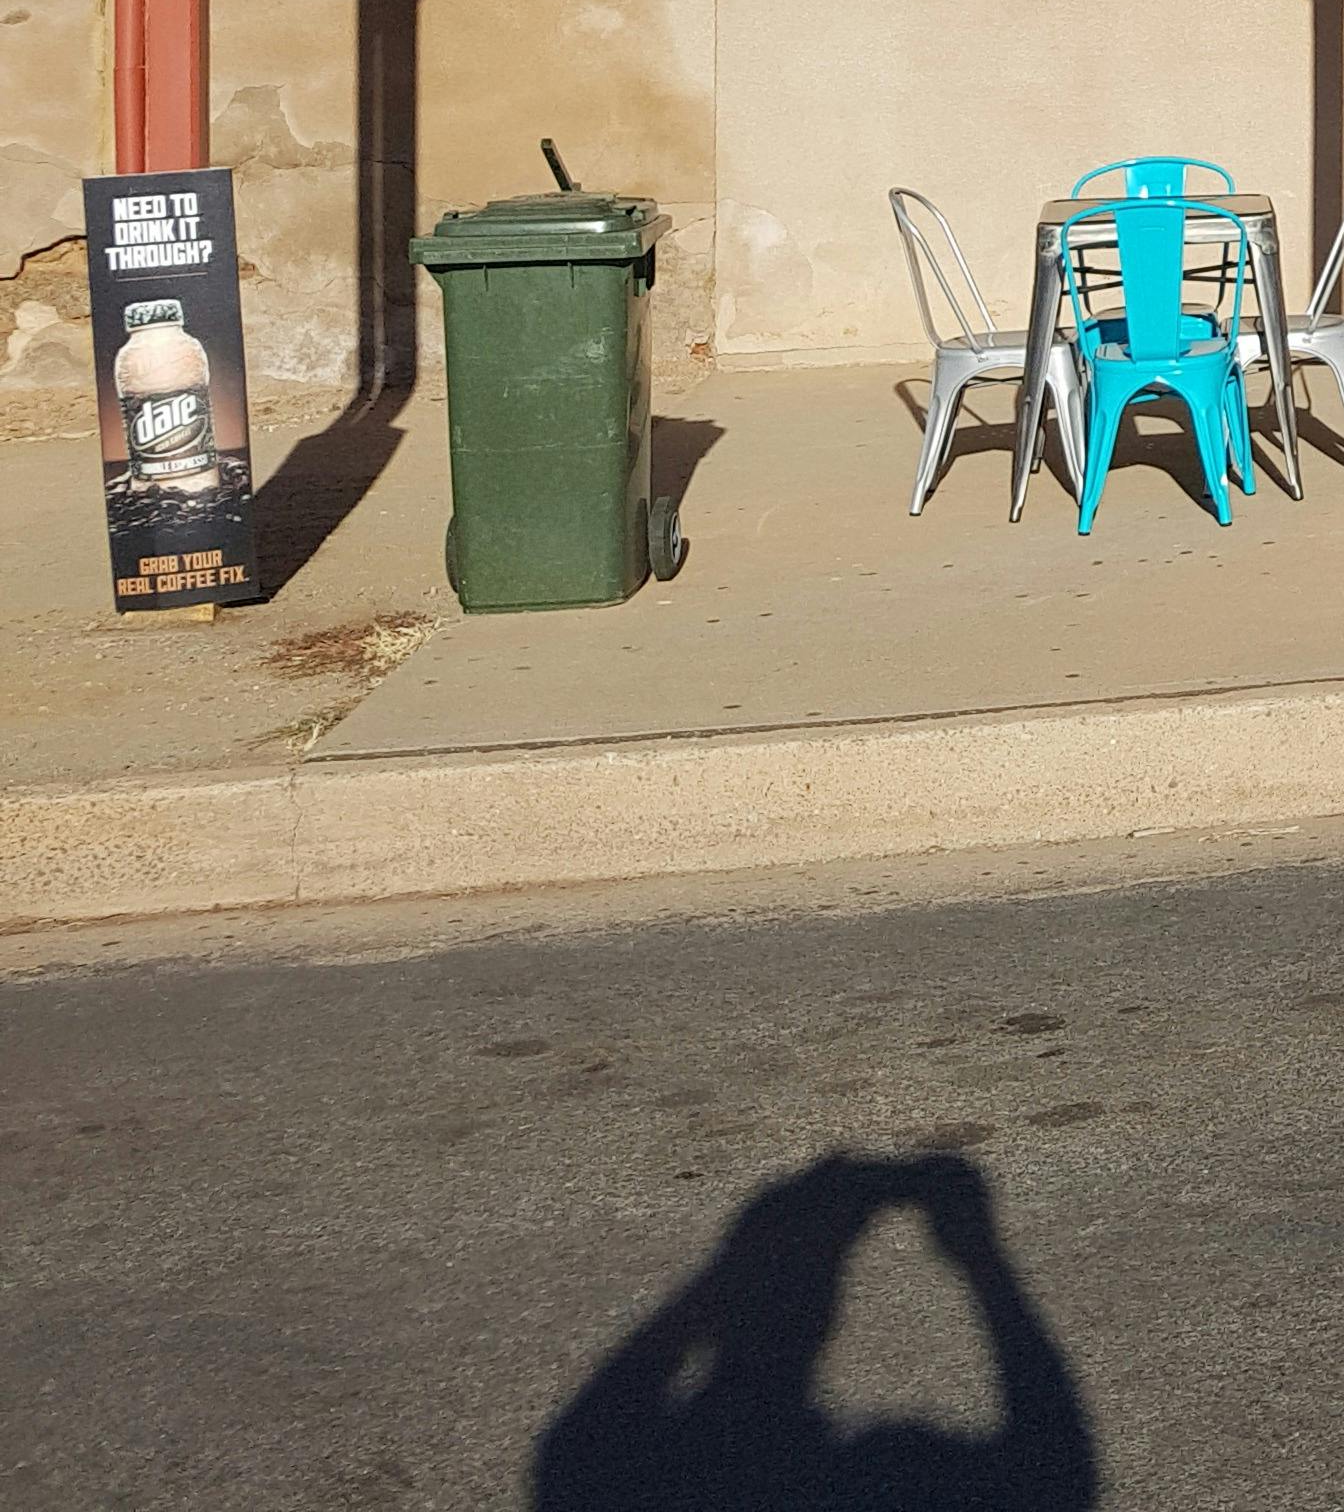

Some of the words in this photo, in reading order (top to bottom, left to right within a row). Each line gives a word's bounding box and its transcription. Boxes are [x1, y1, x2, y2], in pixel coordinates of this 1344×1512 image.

[113, 195, 166, 221] NEED
[169, 193, 198, 216] TO
[115, 219, 175, 245] DRINK
[179, 217, 200, 240] IT
[105, 240, 213, 270] THROUGH?
[137, 393, 198, 443] dare
[140, 555, 178, 575] GRAB
[182, 549, 222, 570] YOUR
[118, 577, 154, 595] REAL
[157, 569, 216, 592] COFFEE
